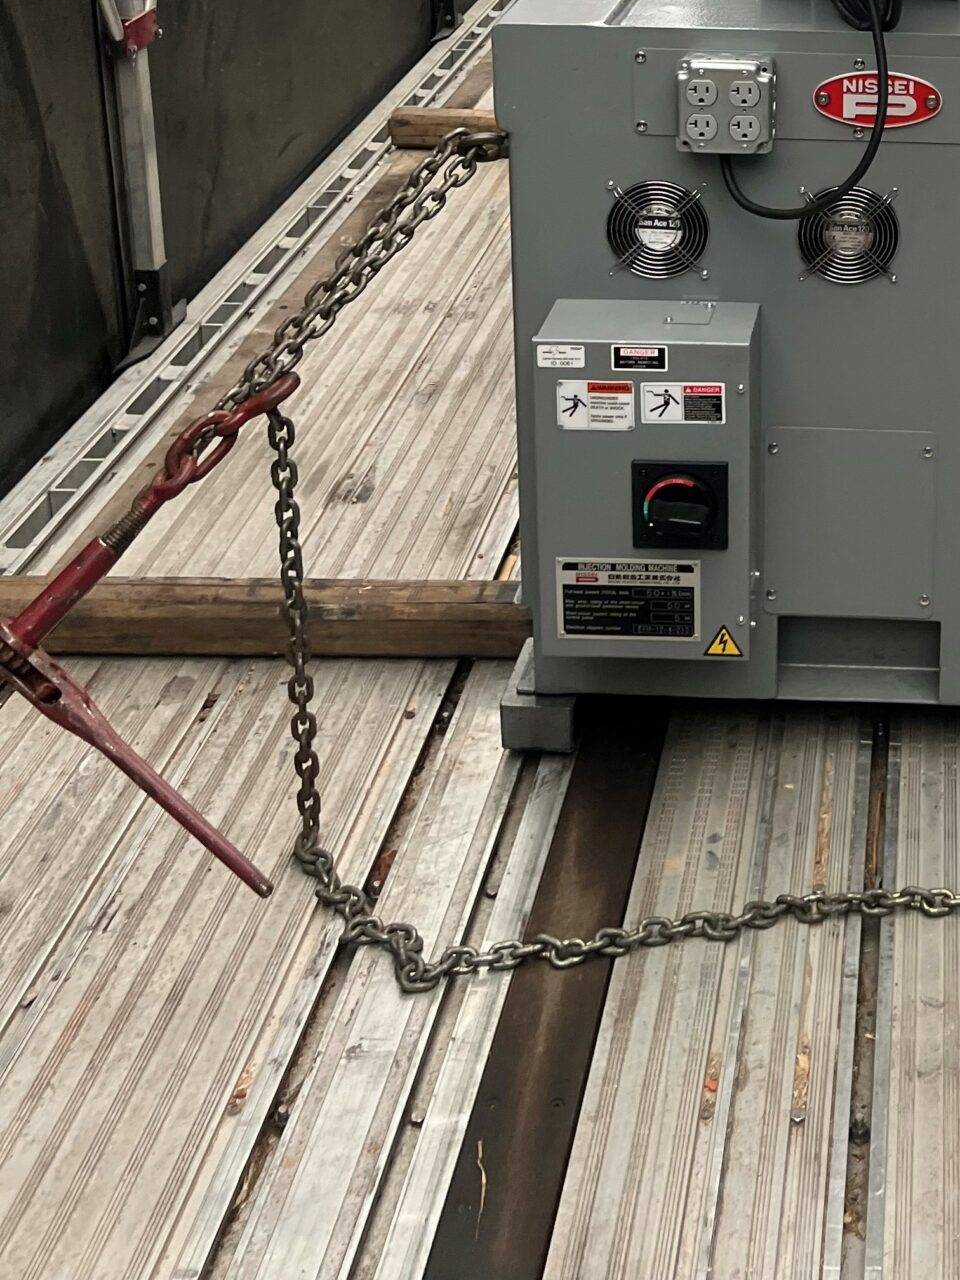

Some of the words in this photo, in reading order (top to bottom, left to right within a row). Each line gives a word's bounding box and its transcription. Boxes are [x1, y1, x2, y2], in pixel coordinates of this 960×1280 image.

[653, 219, 667, 227] Ace
[843, 224, 857, 232] Ace
[577, 563, 611, 571] INJECTION
[615, 563, 646, 572] MOLDING
[648, 564, 678, 573] MACHINE
